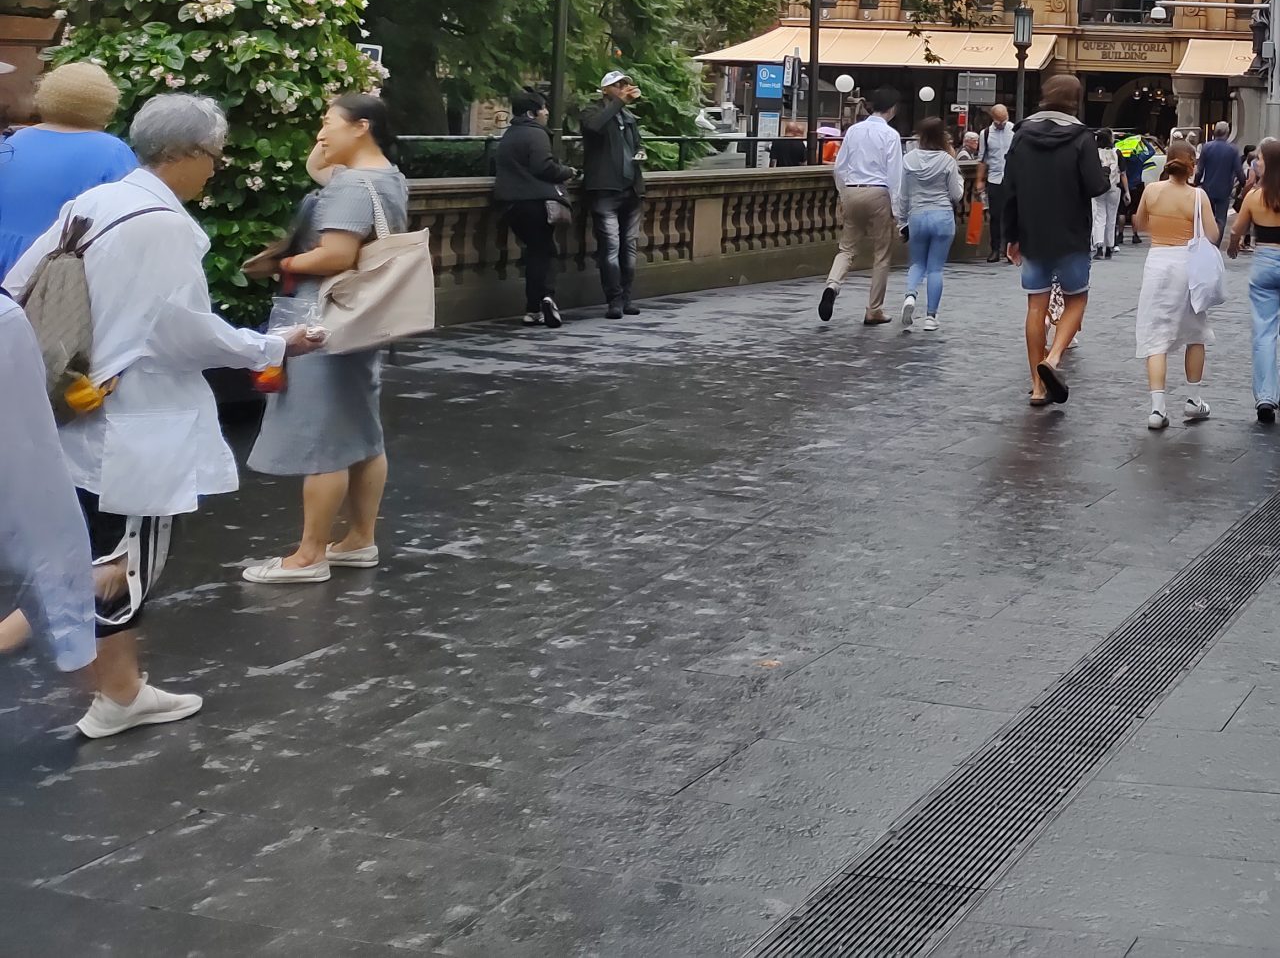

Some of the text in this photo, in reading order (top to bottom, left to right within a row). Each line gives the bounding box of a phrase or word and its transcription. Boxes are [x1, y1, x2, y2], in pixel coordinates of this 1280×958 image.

[1082, 42, 1168, 53] QUEEN VICTORIA
[1101, 51, 1148, 60] BUILDING
